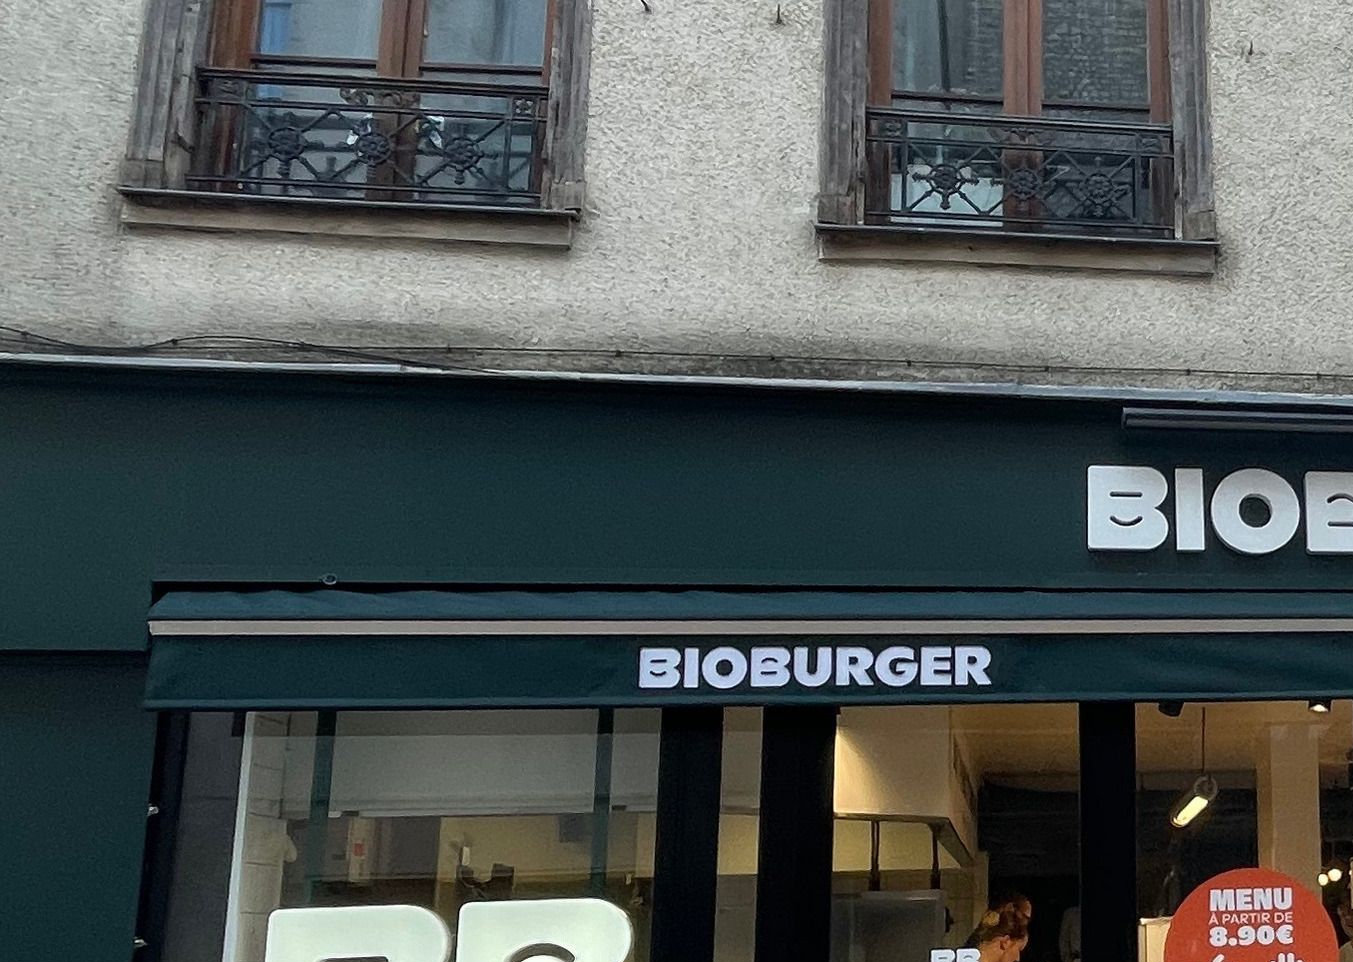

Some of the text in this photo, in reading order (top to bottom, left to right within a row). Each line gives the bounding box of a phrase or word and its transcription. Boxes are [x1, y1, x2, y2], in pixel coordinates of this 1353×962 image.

[638, 646, 992, 689] BIOBURGER
[1209, 887, 1293, 910] MENU
[1222, 913, 1271, 924] PARTIR
[1274, 912, 1293, 923] DE
[1209, 924, 1294, 947] 8.90€
